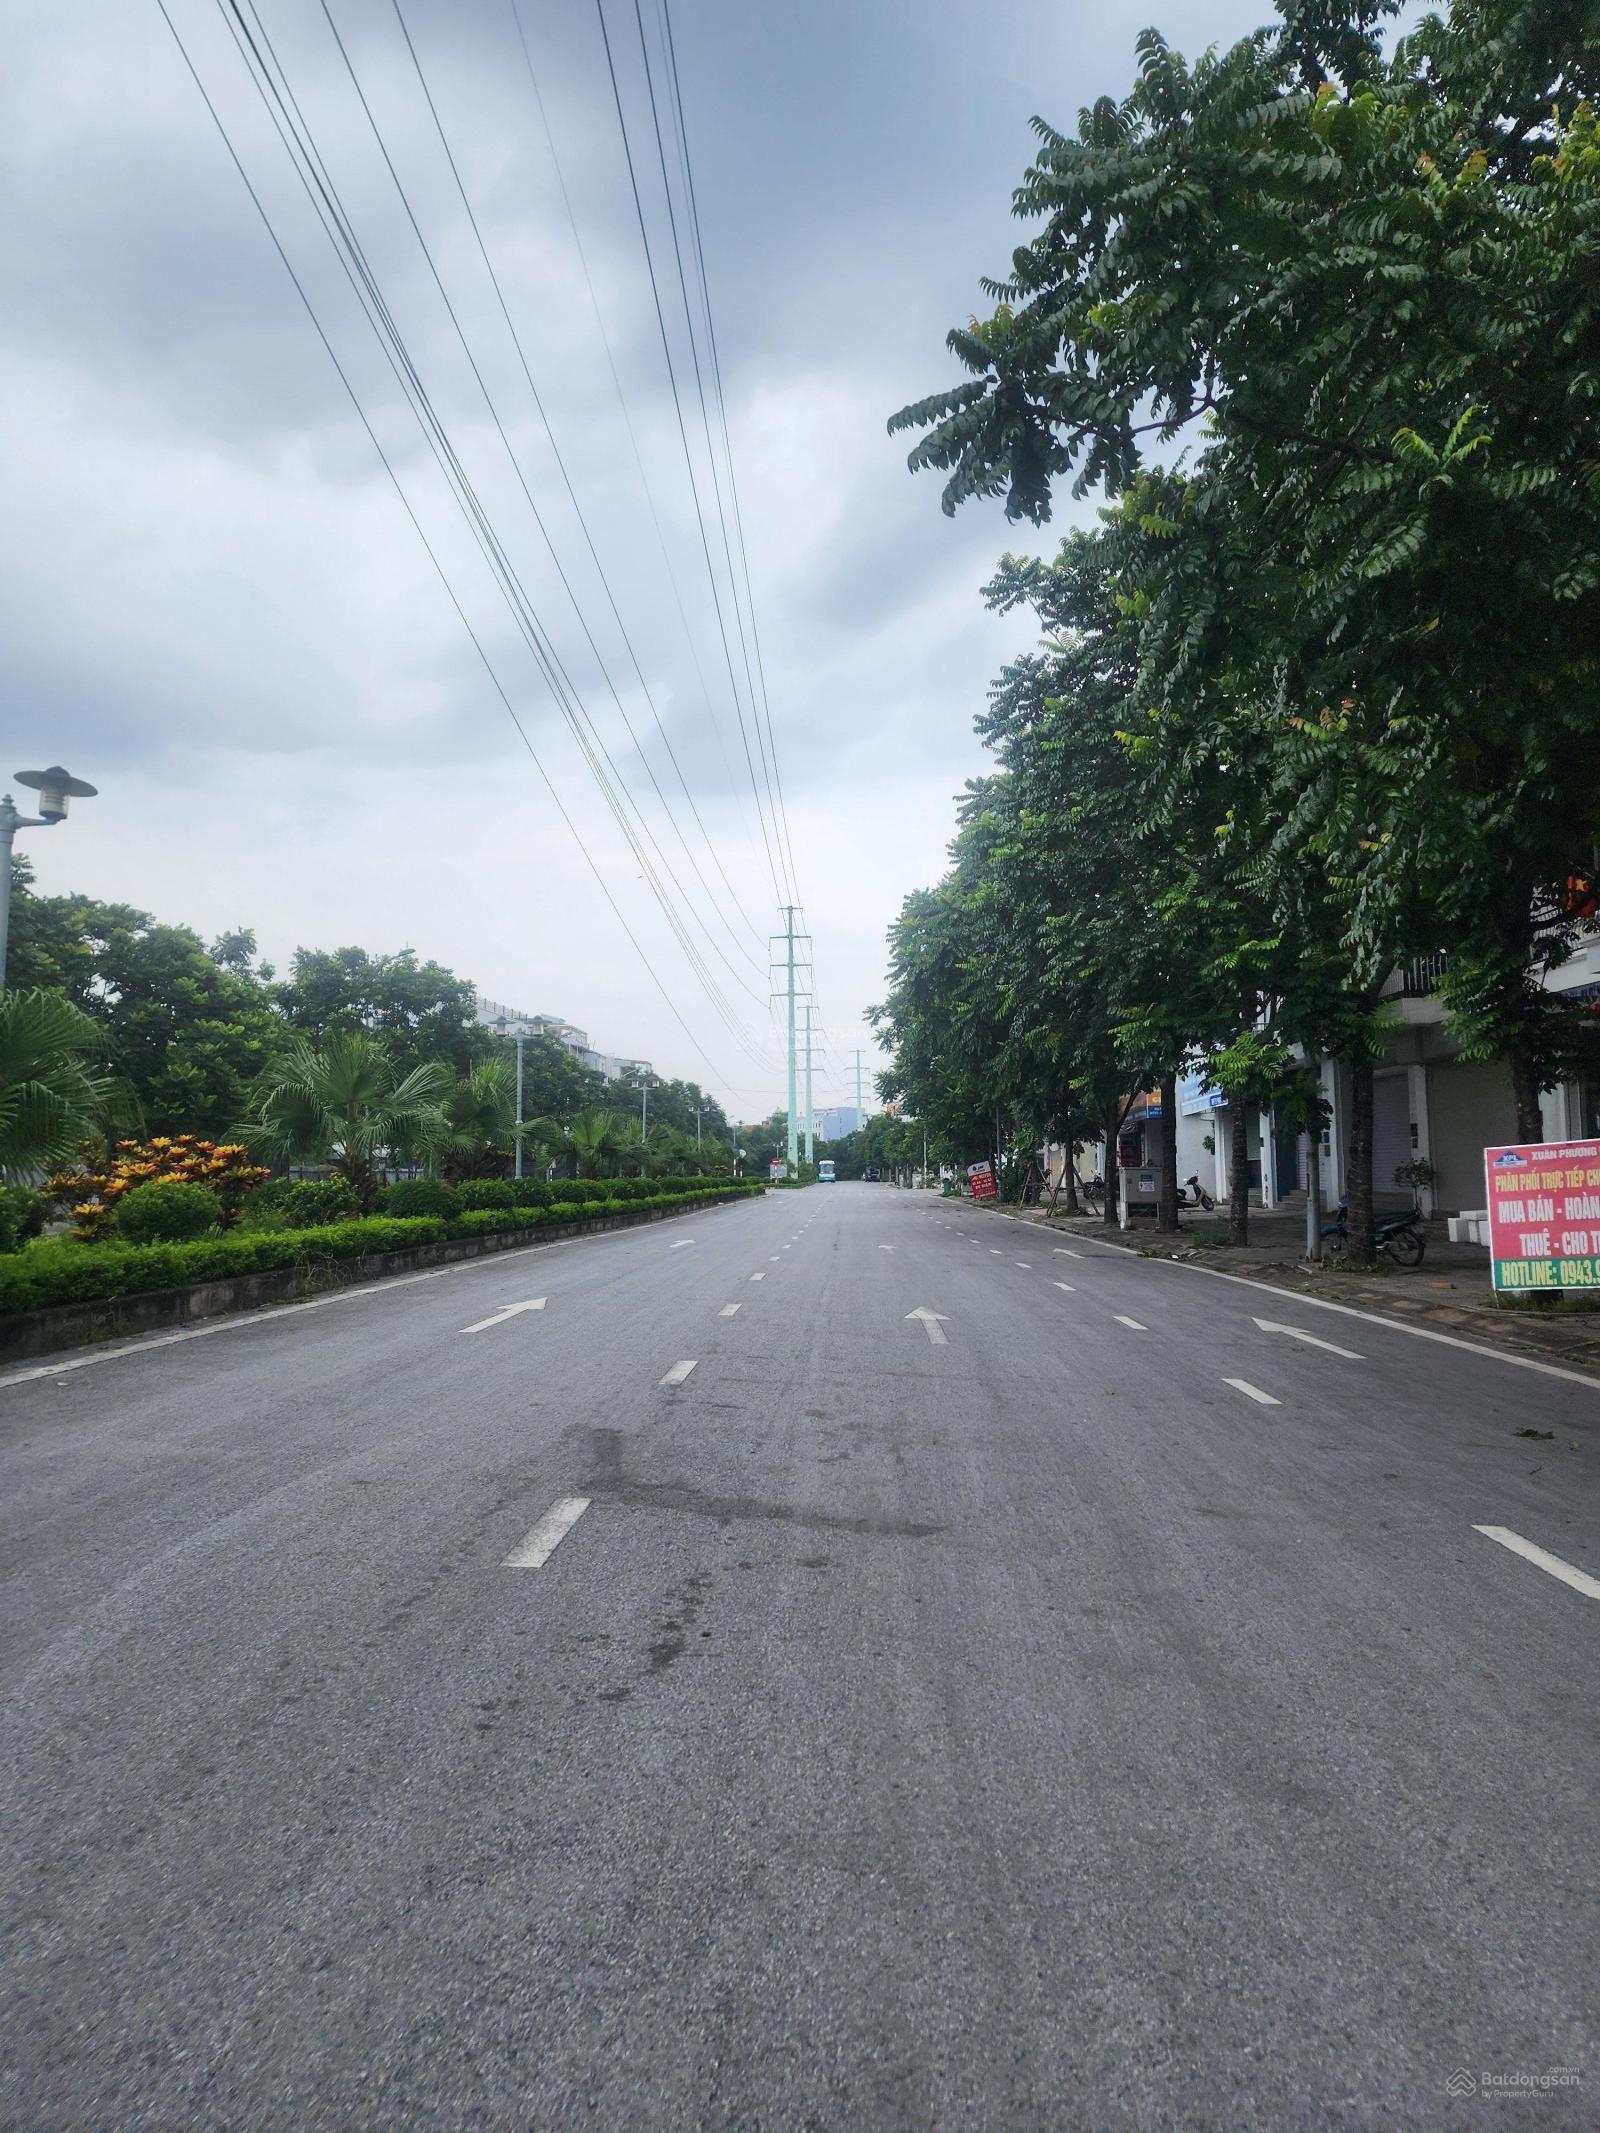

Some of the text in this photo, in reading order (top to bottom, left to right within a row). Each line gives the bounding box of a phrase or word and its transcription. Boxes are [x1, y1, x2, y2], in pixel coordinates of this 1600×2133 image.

[1519, 1167, 1540, 1191] PHỐI
[1565, 1164, 1585, 1188] TIẾP
[1498, 1200, 1525, 1224] MUA
[1527, 1194, 1554, 1222] BÁN
[1519, 1228, 1552, 1256] THUÊ
[1561, 1230, 1588, 1255] CHO
[1501, 1260, 1558, 1286] HOTLINE:
